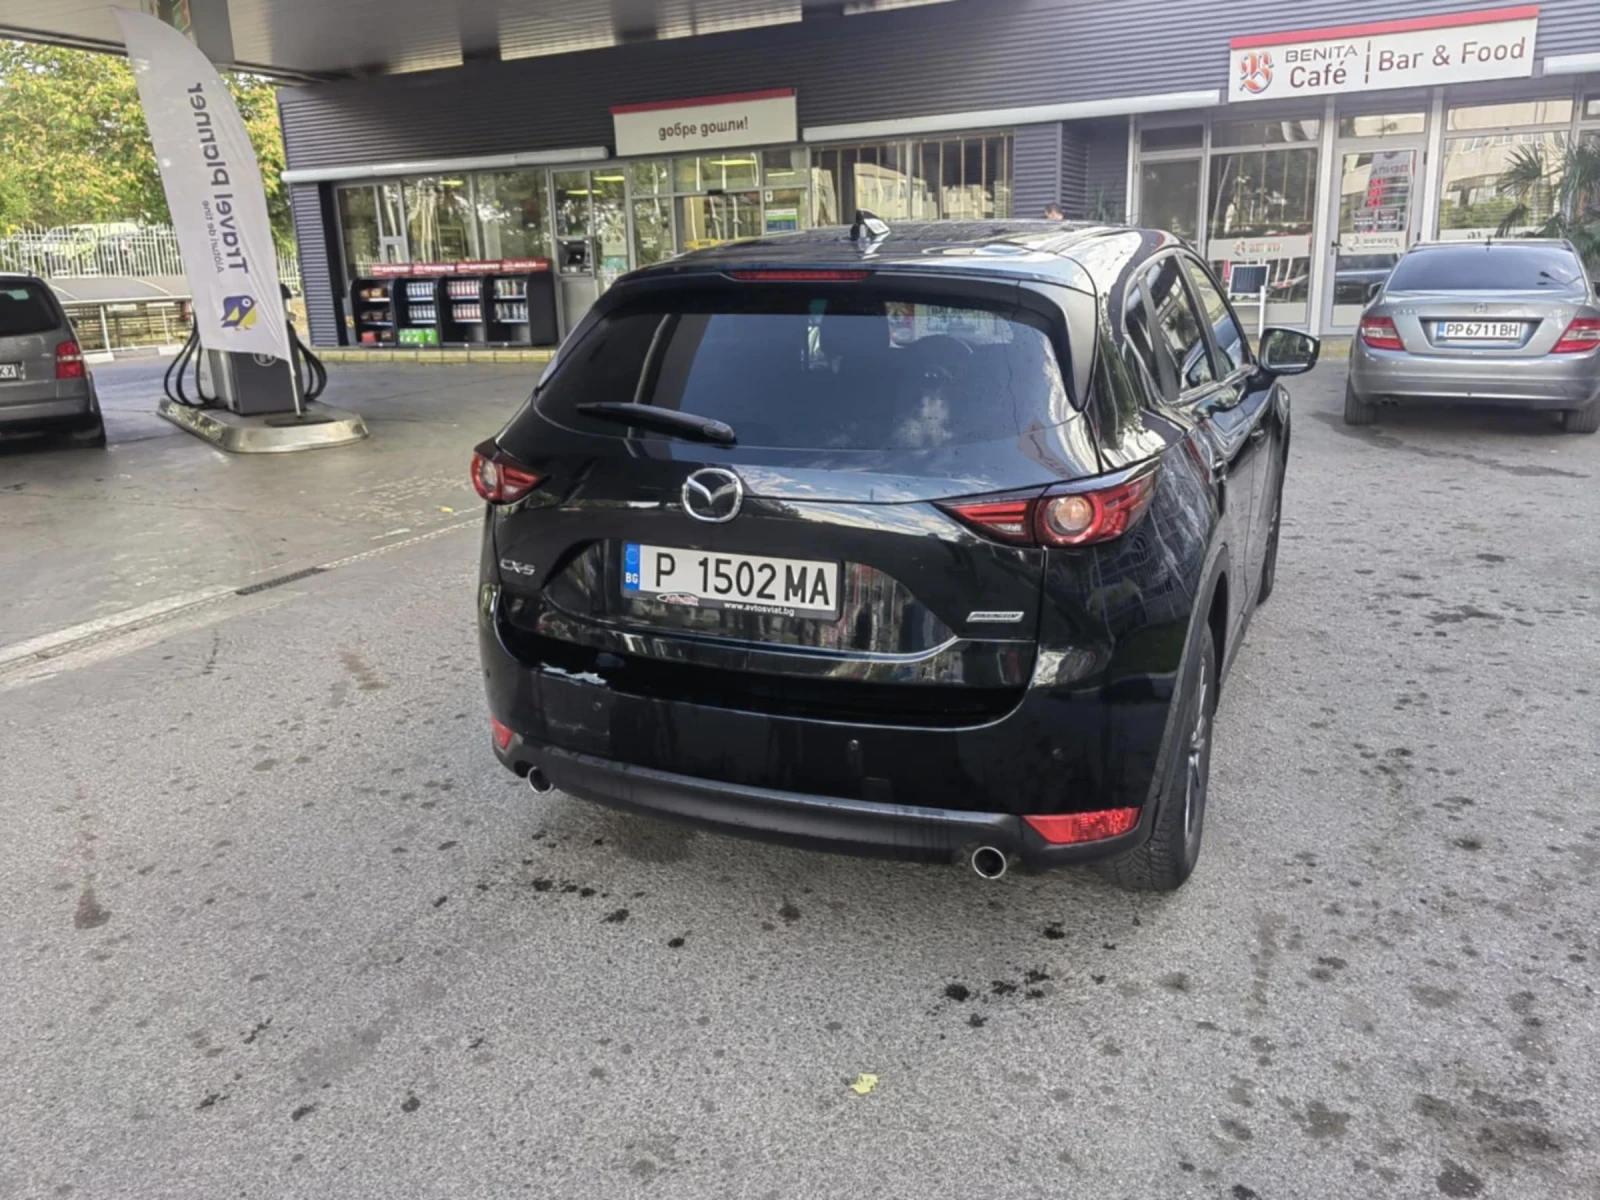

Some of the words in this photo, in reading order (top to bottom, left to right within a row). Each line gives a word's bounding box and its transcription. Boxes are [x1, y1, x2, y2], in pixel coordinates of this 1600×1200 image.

[1285, 44, 1358, 63] BENITA
[1379, 50, 1424, 72] Bar
[1432, 44, 1450, 67] &
[1461, 37, 1526, 64] Food
[1289, 61, 1347, 88] Café
[658, 122, 697, 141] добре
[700, 116, 749, 137] дошли!
[1446, 324, 1464, 336] PP
[1466, 324, 1497, 336] 6711
[1499, 325, 1518, 336] BH
[500, 558, 535, 576] CX-5
[625, 572, 639, 583] BG
[656, 552, 676, 587] P
[698, 557, 777, 600] 1502
[784, 564, 830, 606] MA
[724, 602, 795, 617] www.avtosviat.bg
